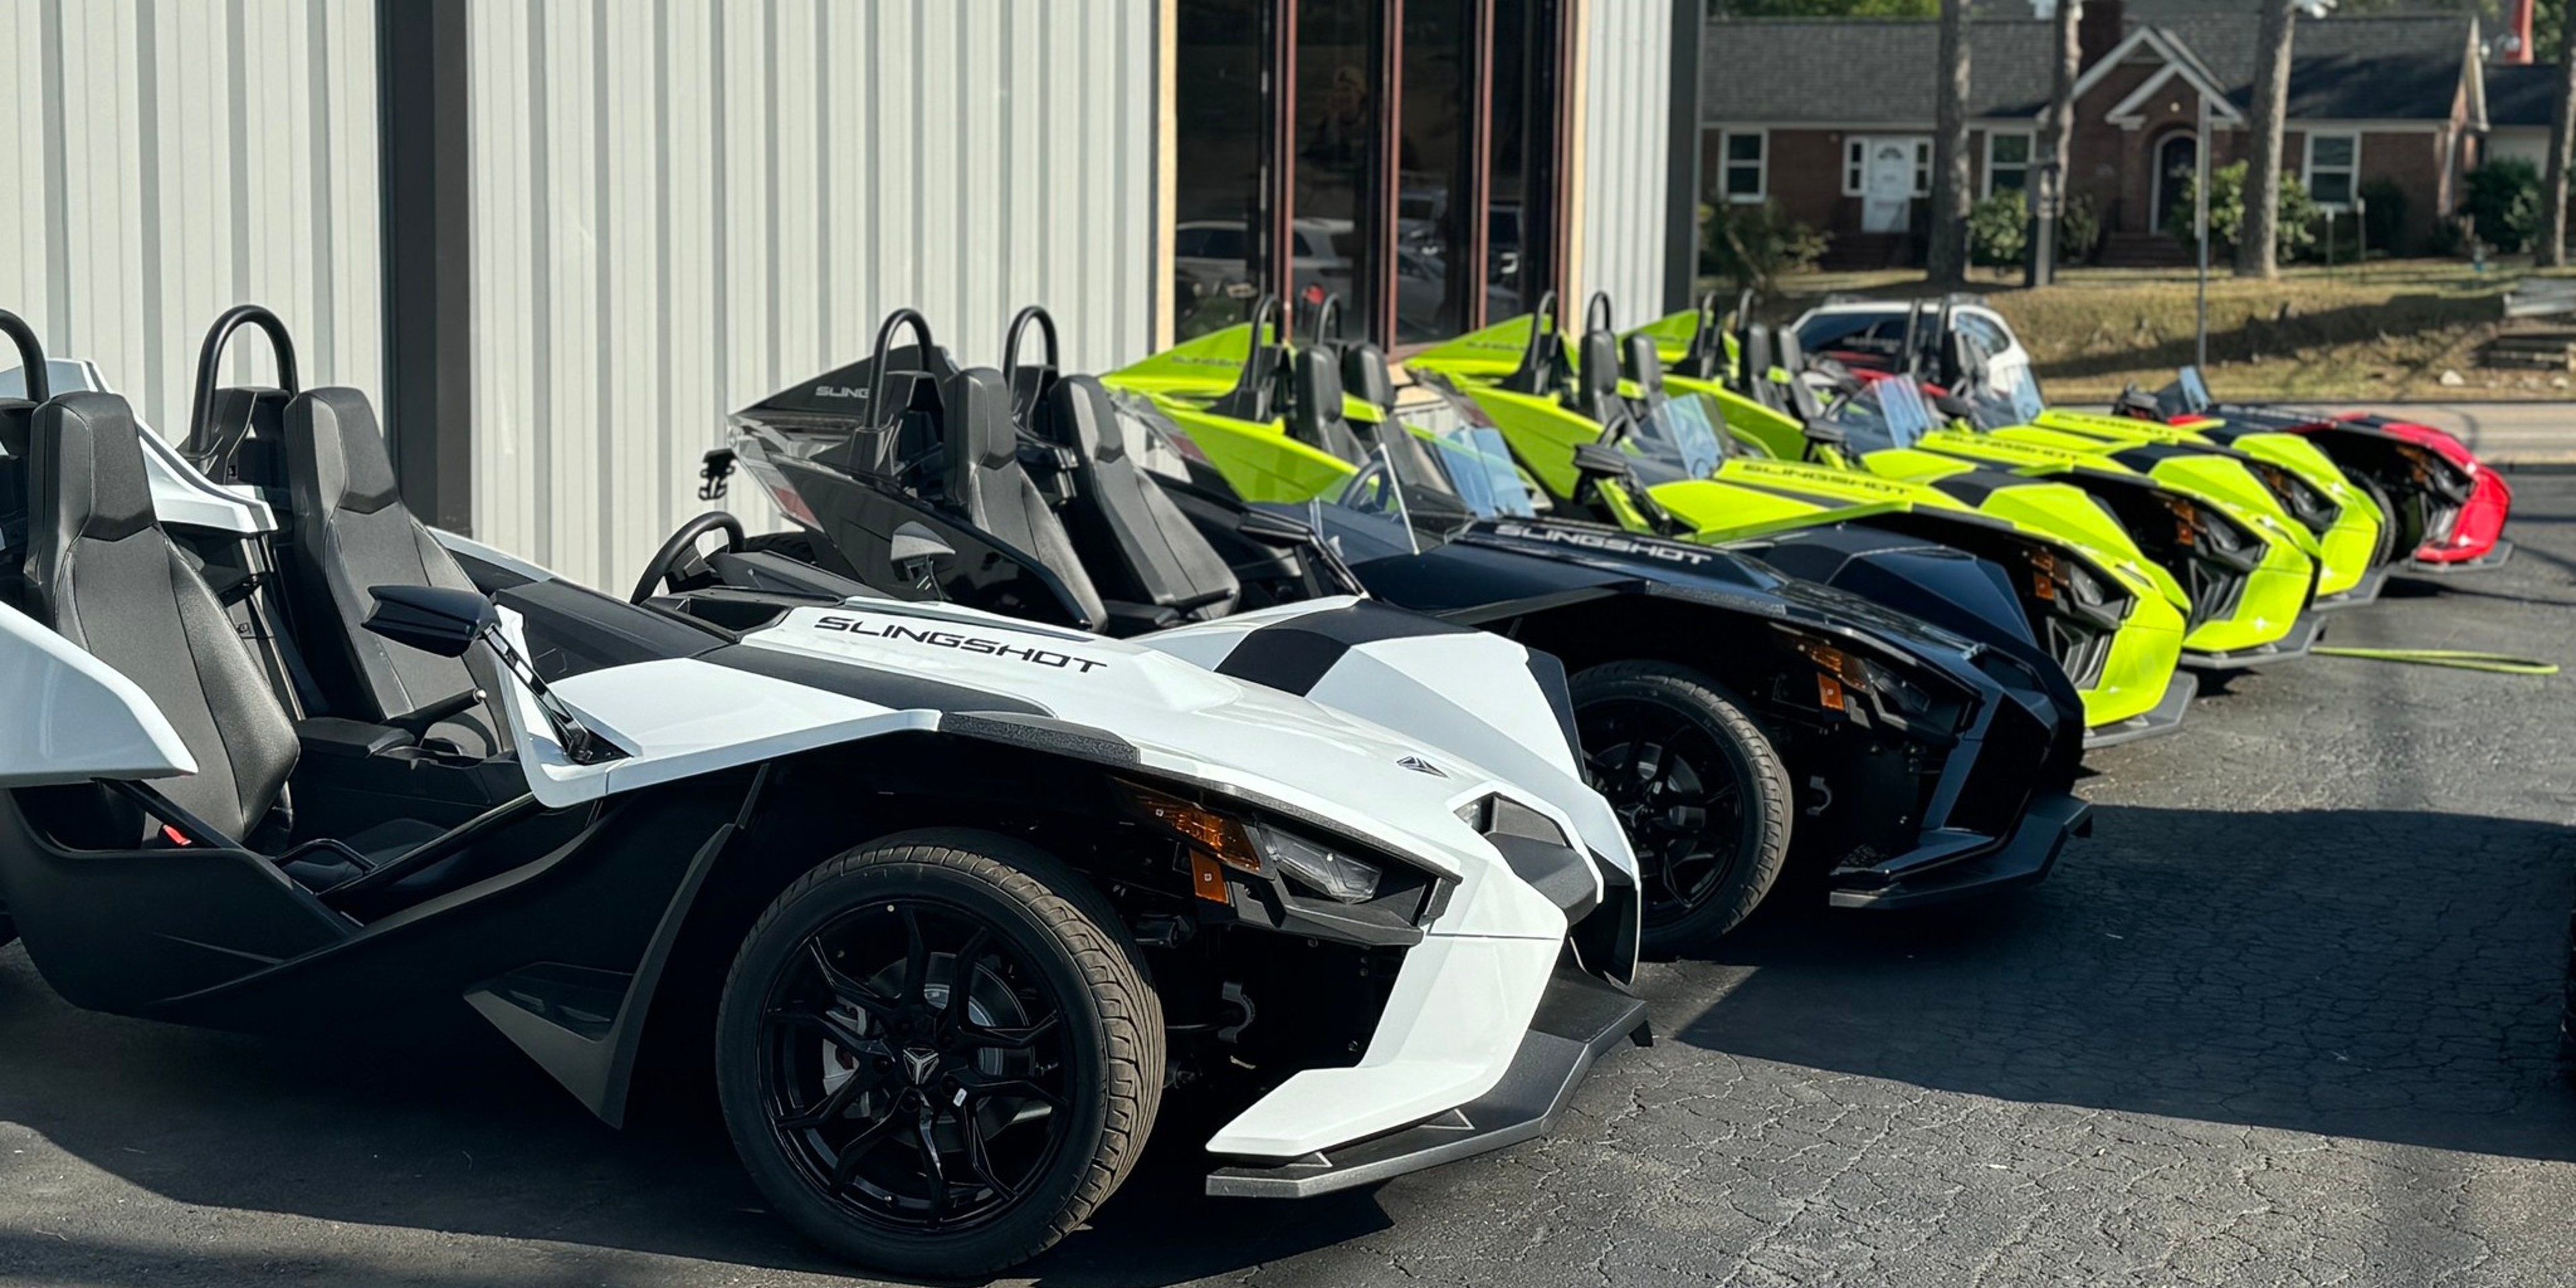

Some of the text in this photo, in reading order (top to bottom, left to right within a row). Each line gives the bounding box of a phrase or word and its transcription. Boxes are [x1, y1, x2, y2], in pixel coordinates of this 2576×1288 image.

[815, 385, 871, 399] SLING
[1742, 464, 1913, 495] SLINGSHOT
[1494, 523, 1713, 566] SLINGSHOT
[814, 615, 1108, 674] SLINGSHOT
